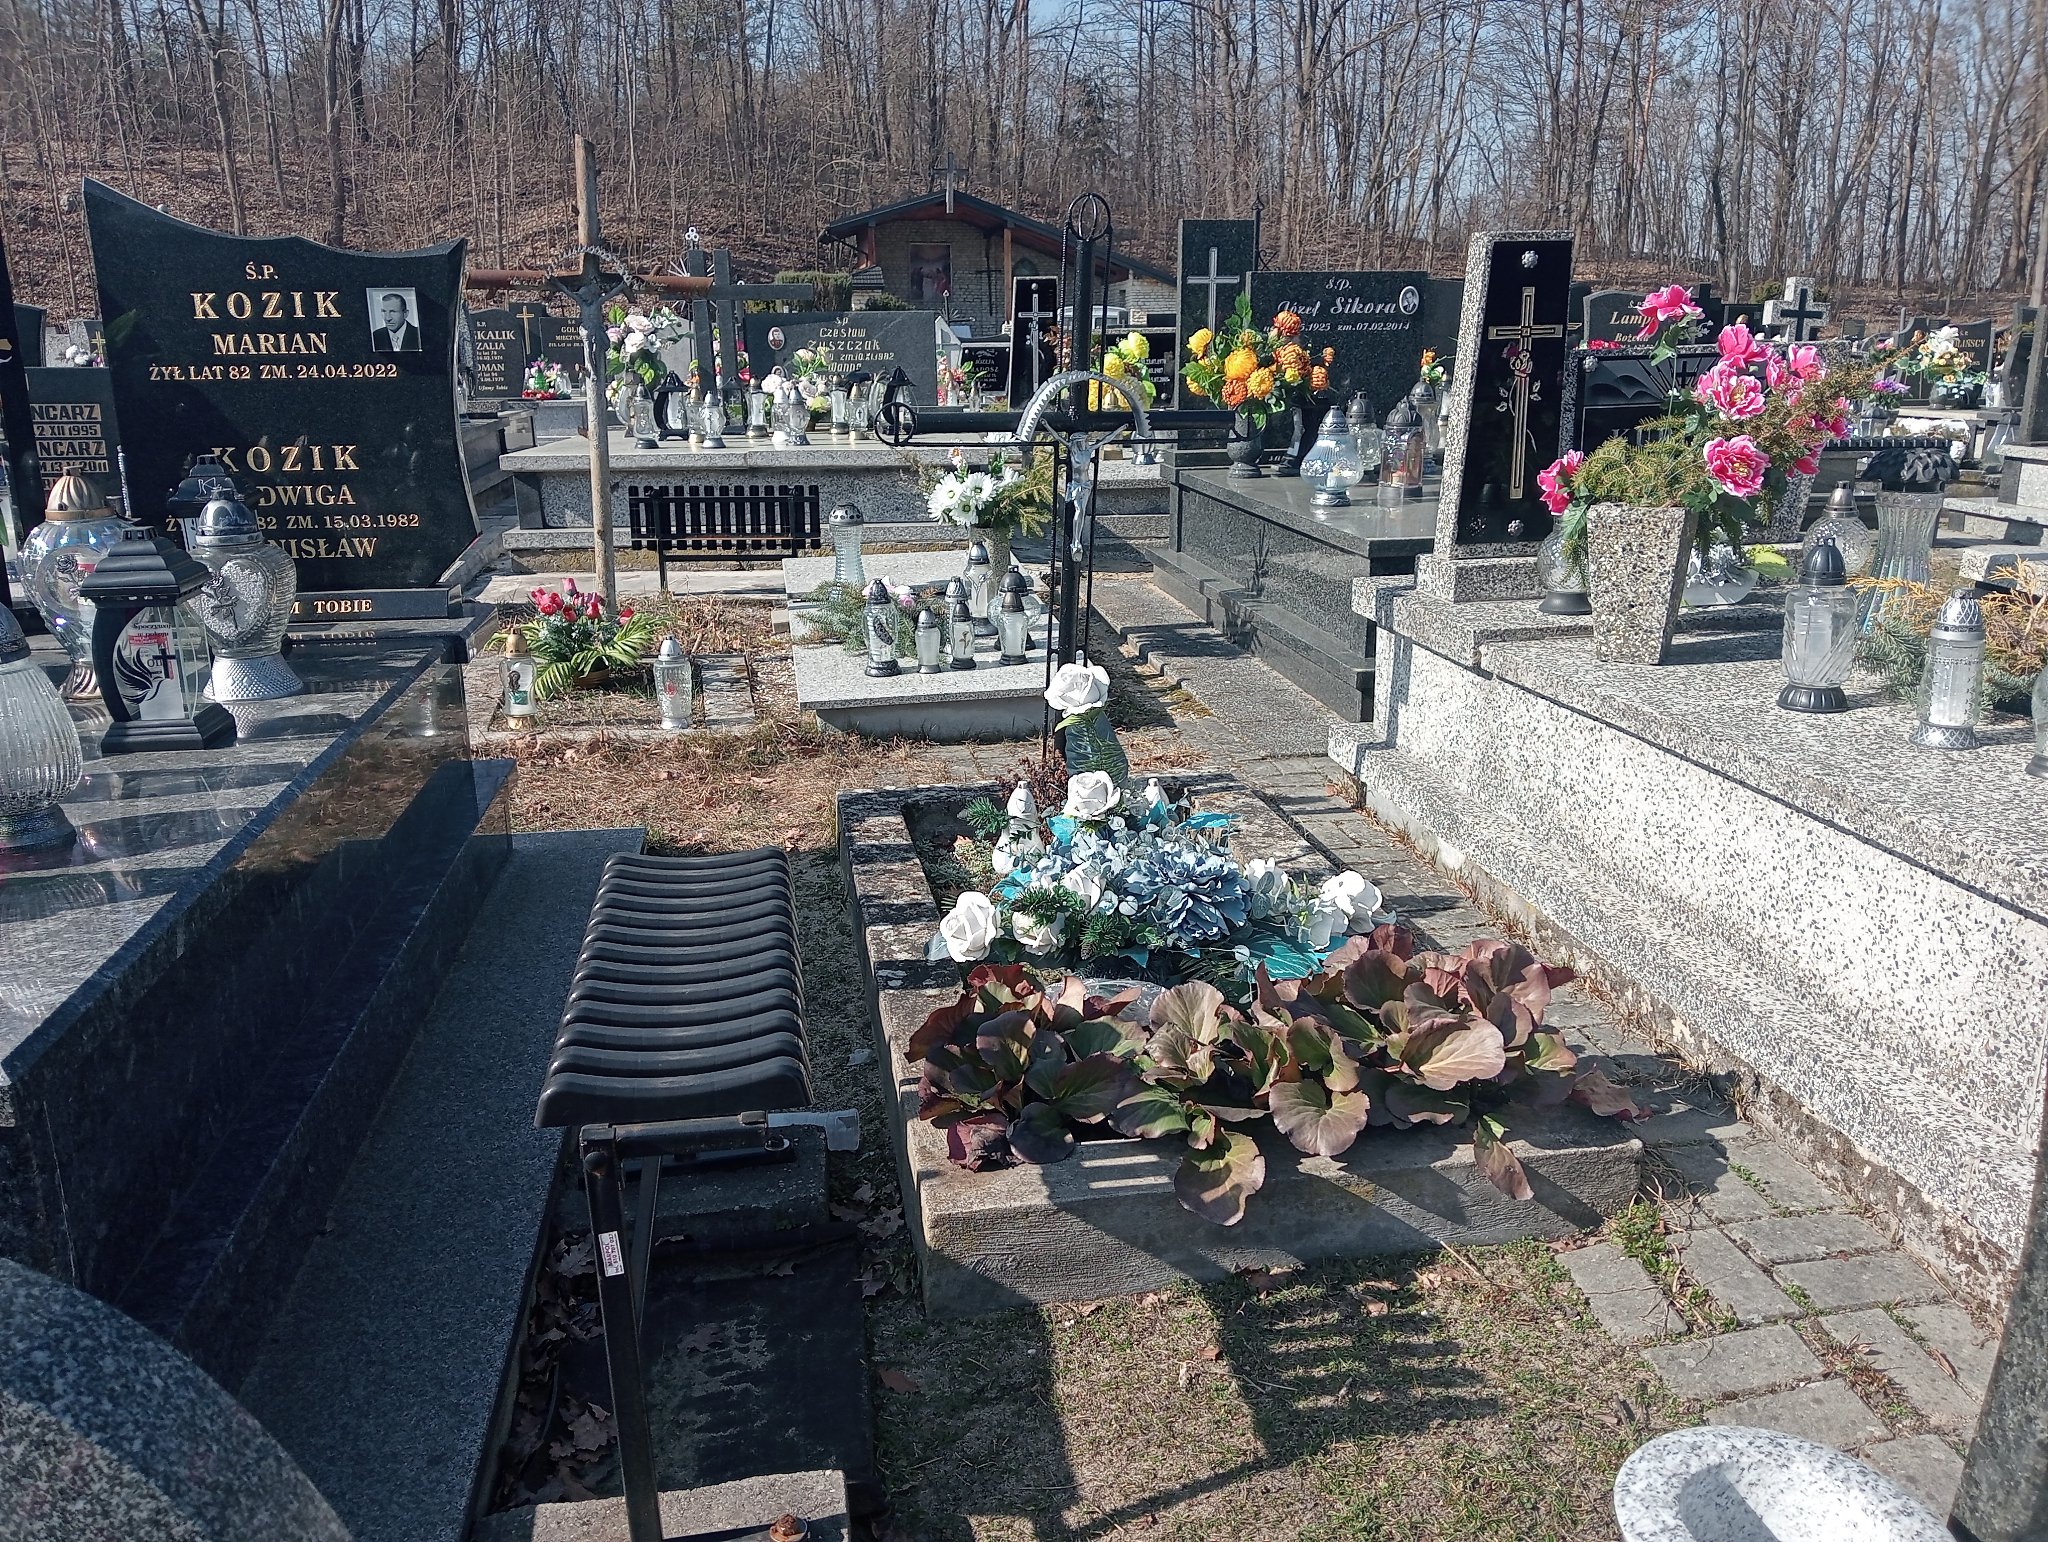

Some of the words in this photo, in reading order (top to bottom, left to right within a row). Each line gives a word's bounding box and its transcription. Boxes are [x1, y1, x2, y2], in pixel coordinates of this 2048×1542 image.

[245, 262, 279, 280] Ś.P.
[190, 291, 342, 319] KOZIK
[1330, 296, 1397, 314] Sikora
[1610, 312, 1652, 327] Lamp
[211, 332, 329, 355] MARIAN
[149, 363, 185, 381] ŻYŁ
[187, 366, 224, 380] LAT
[228, 365, 251, 380] 82
[259, 364, 293, 379] ZM.
[297, 363, 398, 379] 24.04.2022
[31, 405, 98, 420] NCARZ
[68, 425, 98, 437] 1995
[39, 441, 104, 457] NCARZ
[80, 461, 108, 472] 2011
[211, 445, 359, 473] KOZIK
[256, 484, 357, 506] DWIGA
[286, 515, 319, 530] ZM.
[324, 513, 420, 530] 15.03.1982
[268, 537, 378, 559] NISŁAW
[313, 599, 373, 614] TOBIE
